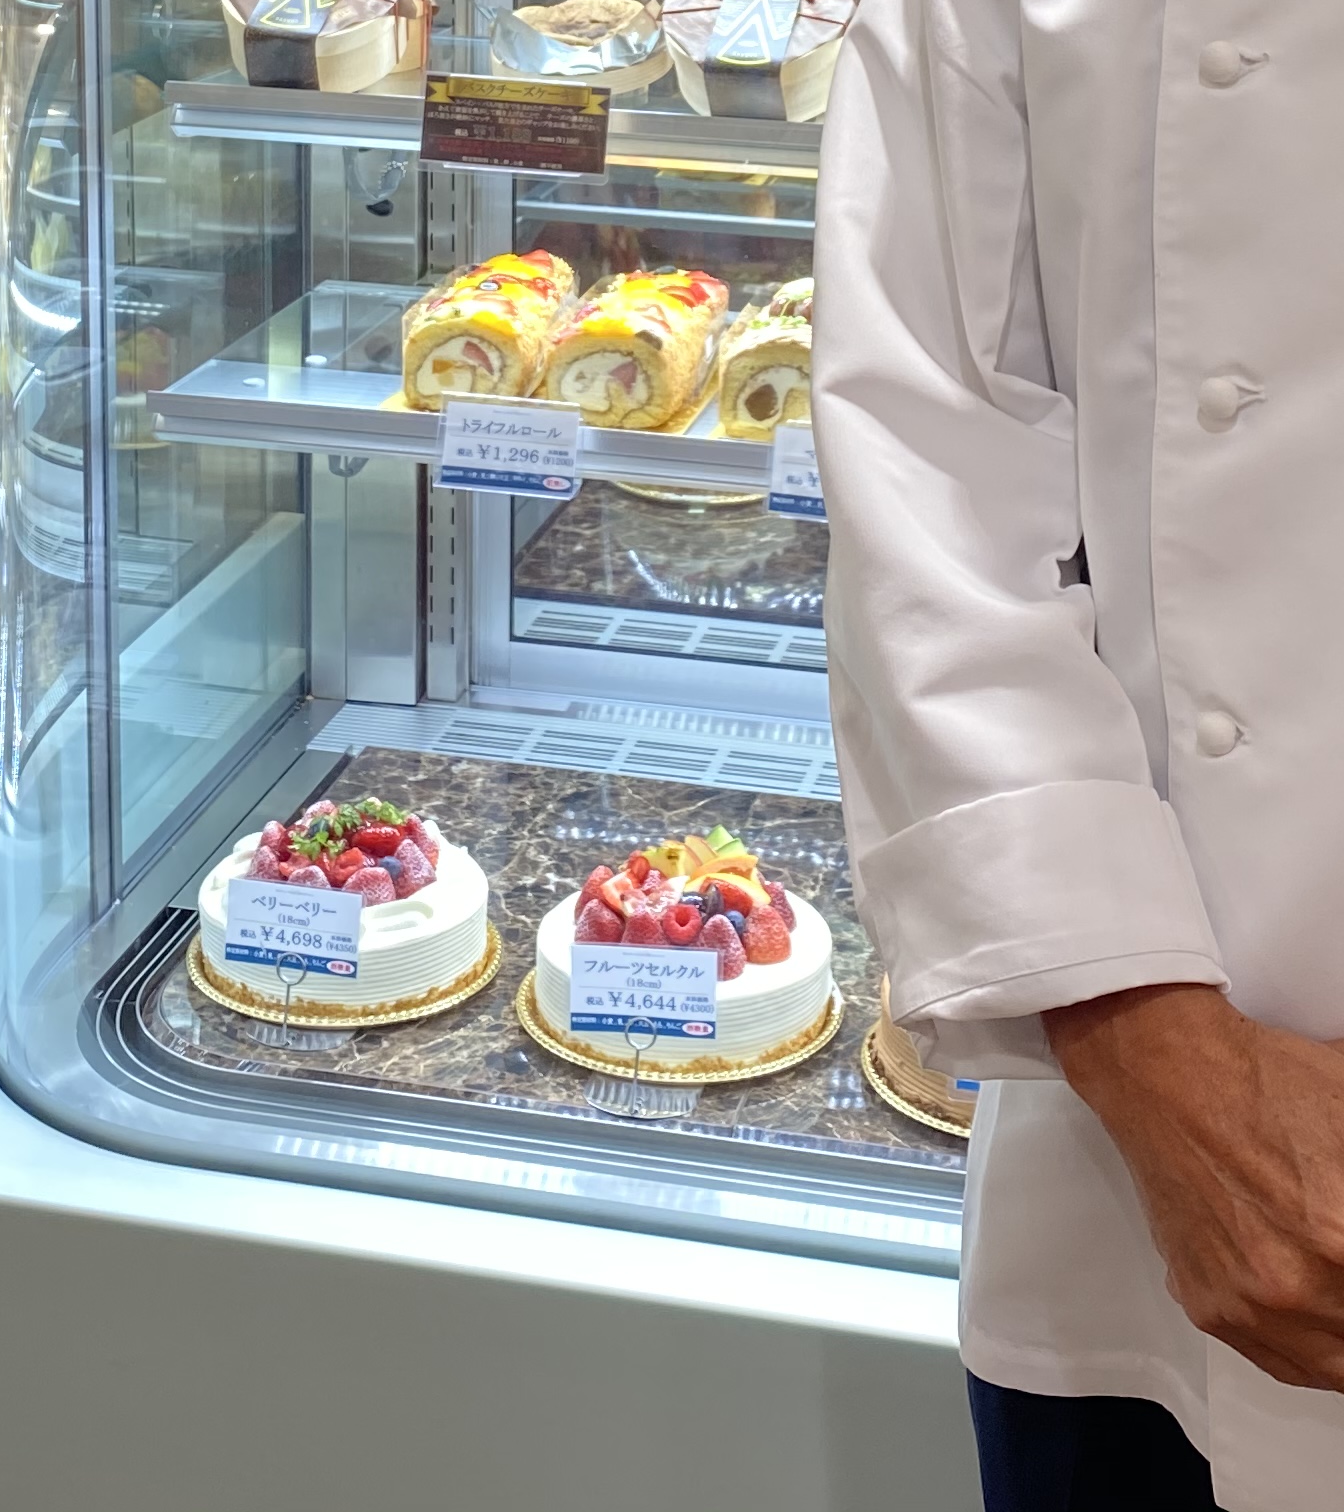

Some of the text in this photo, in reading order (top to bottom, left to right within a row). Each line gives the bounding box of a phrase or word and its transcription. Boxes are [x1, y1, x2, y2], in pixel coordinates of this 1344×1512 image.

[462, 418, 562, 439] トライフルロール
[477, 444, 540, 463] ¥1,296
[251, 895, 337, 917] ベリーベリー
[260, 926, 323, 949] ¥4,698
[584, 959, 705, 979] フルーツセルクル
[626, 977, 662, 989] (18cm)
[608, 991, 677, 1012] ¥4,644
